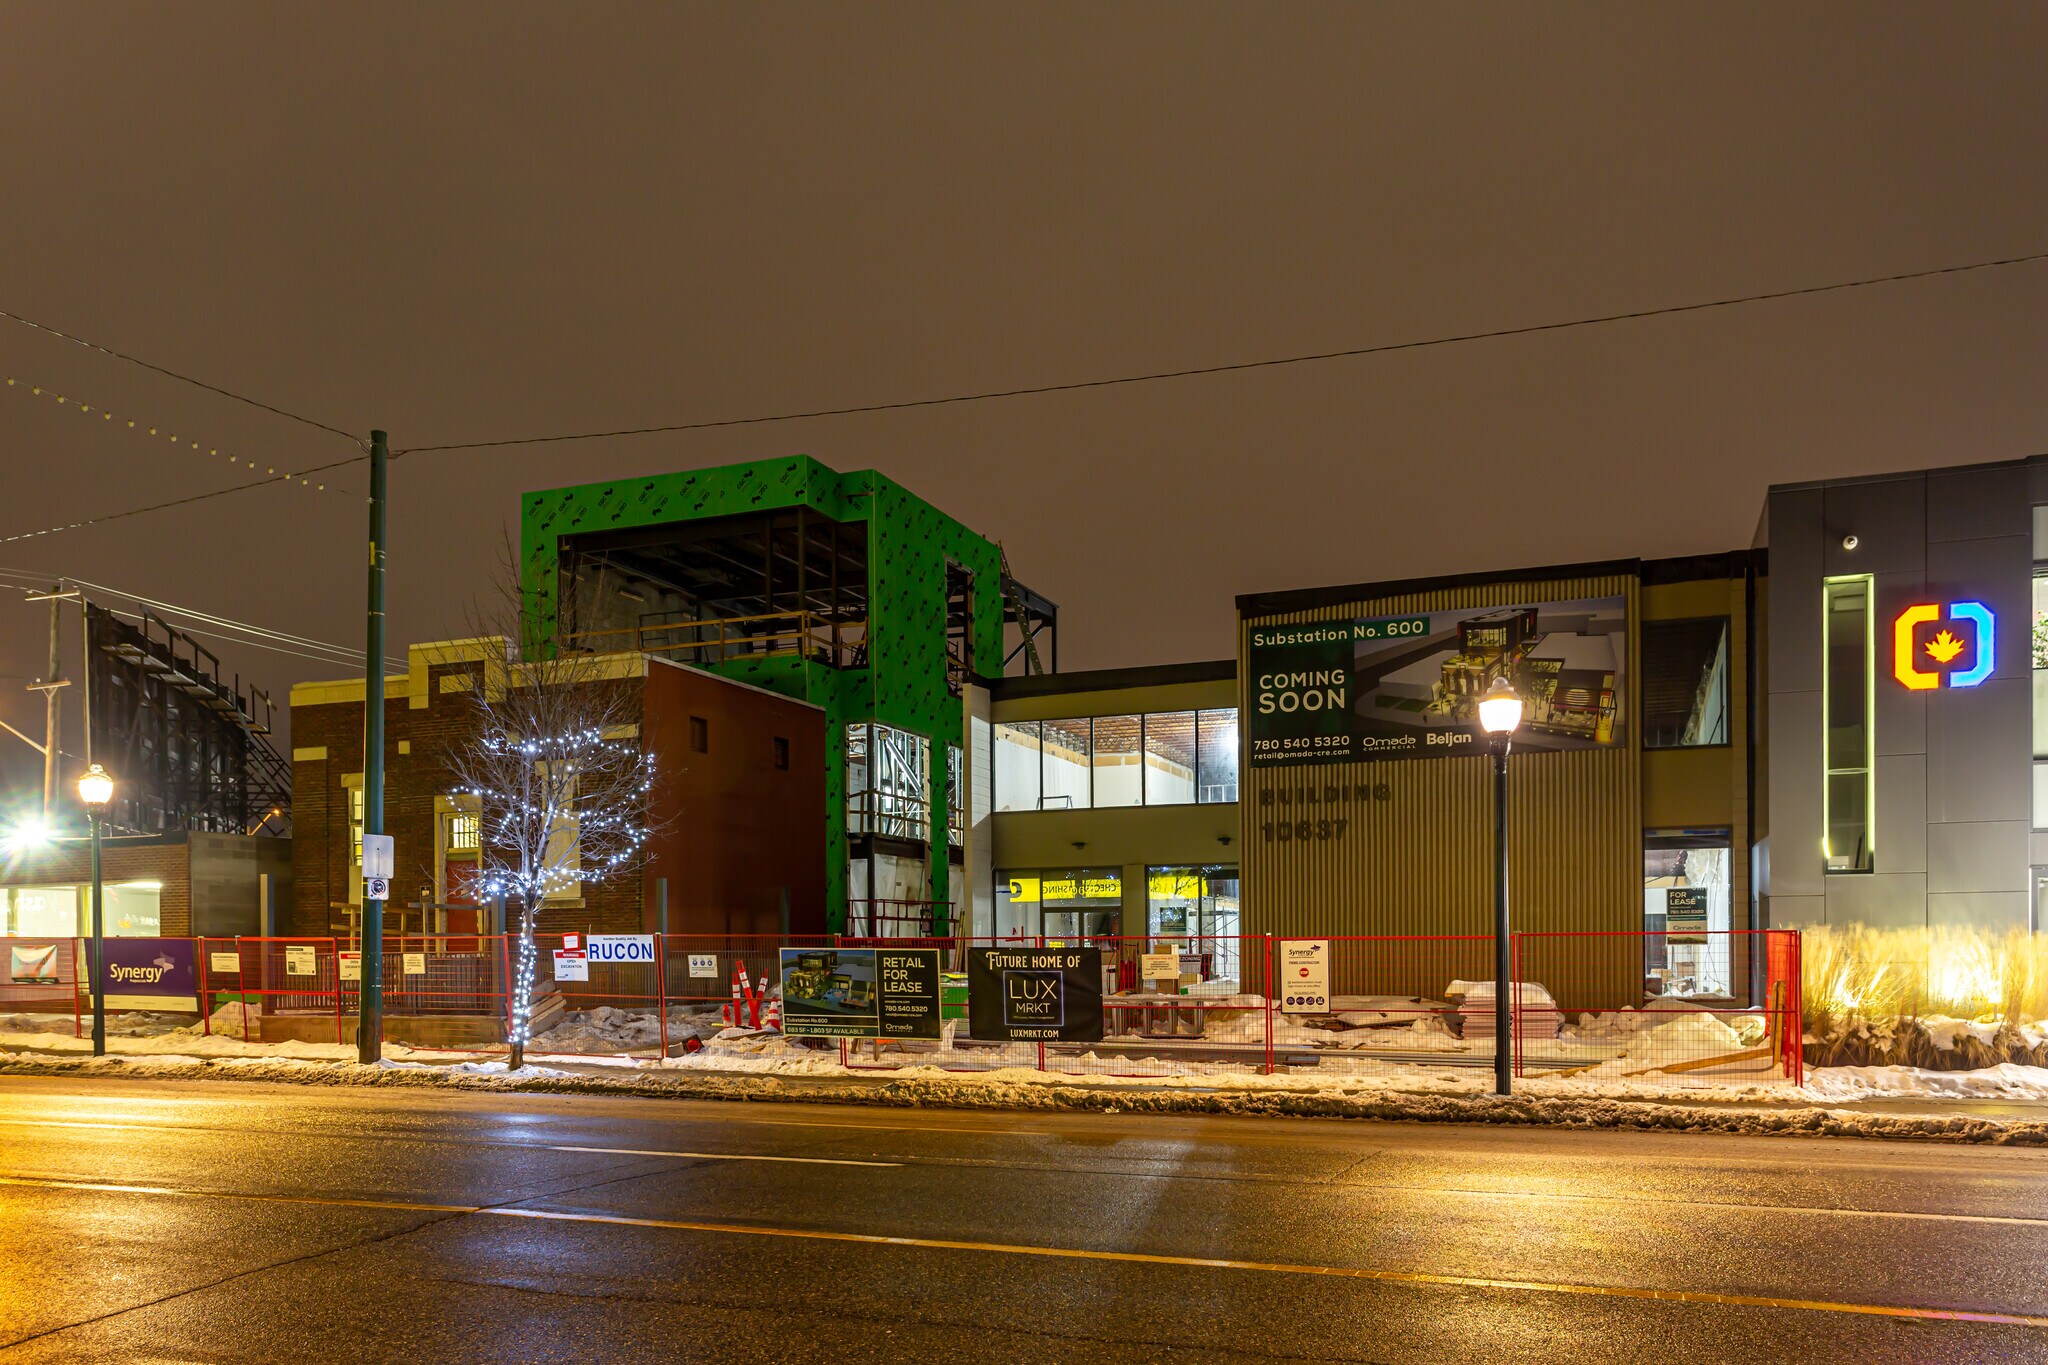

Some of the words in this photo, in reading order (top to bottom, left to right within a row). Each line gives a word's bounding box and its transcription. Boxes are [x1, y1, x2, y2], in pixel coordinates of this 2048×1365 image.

[1254, 629, 1347, 647] Substation
[1354, 626, 1381, 639] No.
[1387, 620, 1424, 635] 600
[1259, 669, 1345, 690] COMING
[1258, 688, 1345, 714] SOON
[1254, 740, 1279, 751] 780
[1283, 738, 1310, 749] 540
[1314, 735, 1350, 747] 5320
[1363, 734, 1416, 747] Omada
[1426, 732, 1472, 747] Beljan
[1254, 749, 1350, 760] retail@omada-cre.com
[1259, 783, 1391, 806] BUILDING
[1262, 818, 1348, 842] 10637
[589, 943, 653, 960] RUCON
[883, 957, 925, 968] RETAIL
[1032, 955, 1062, 968] HOME
[1067, 955, 1081, 968] OF
[110, 963, 163, 983] Synergy
[883, 969, 908, 980] FOR
[884, 982, 923, 993] LEASE
[1009, 979, 1057, 999] LUX
[1016, 1002, 1051, 1013] MRKT
[885, 1023, 913, 1031] Omada
[1010, 1029, 1059, 1038] LUXMRKT.COM
